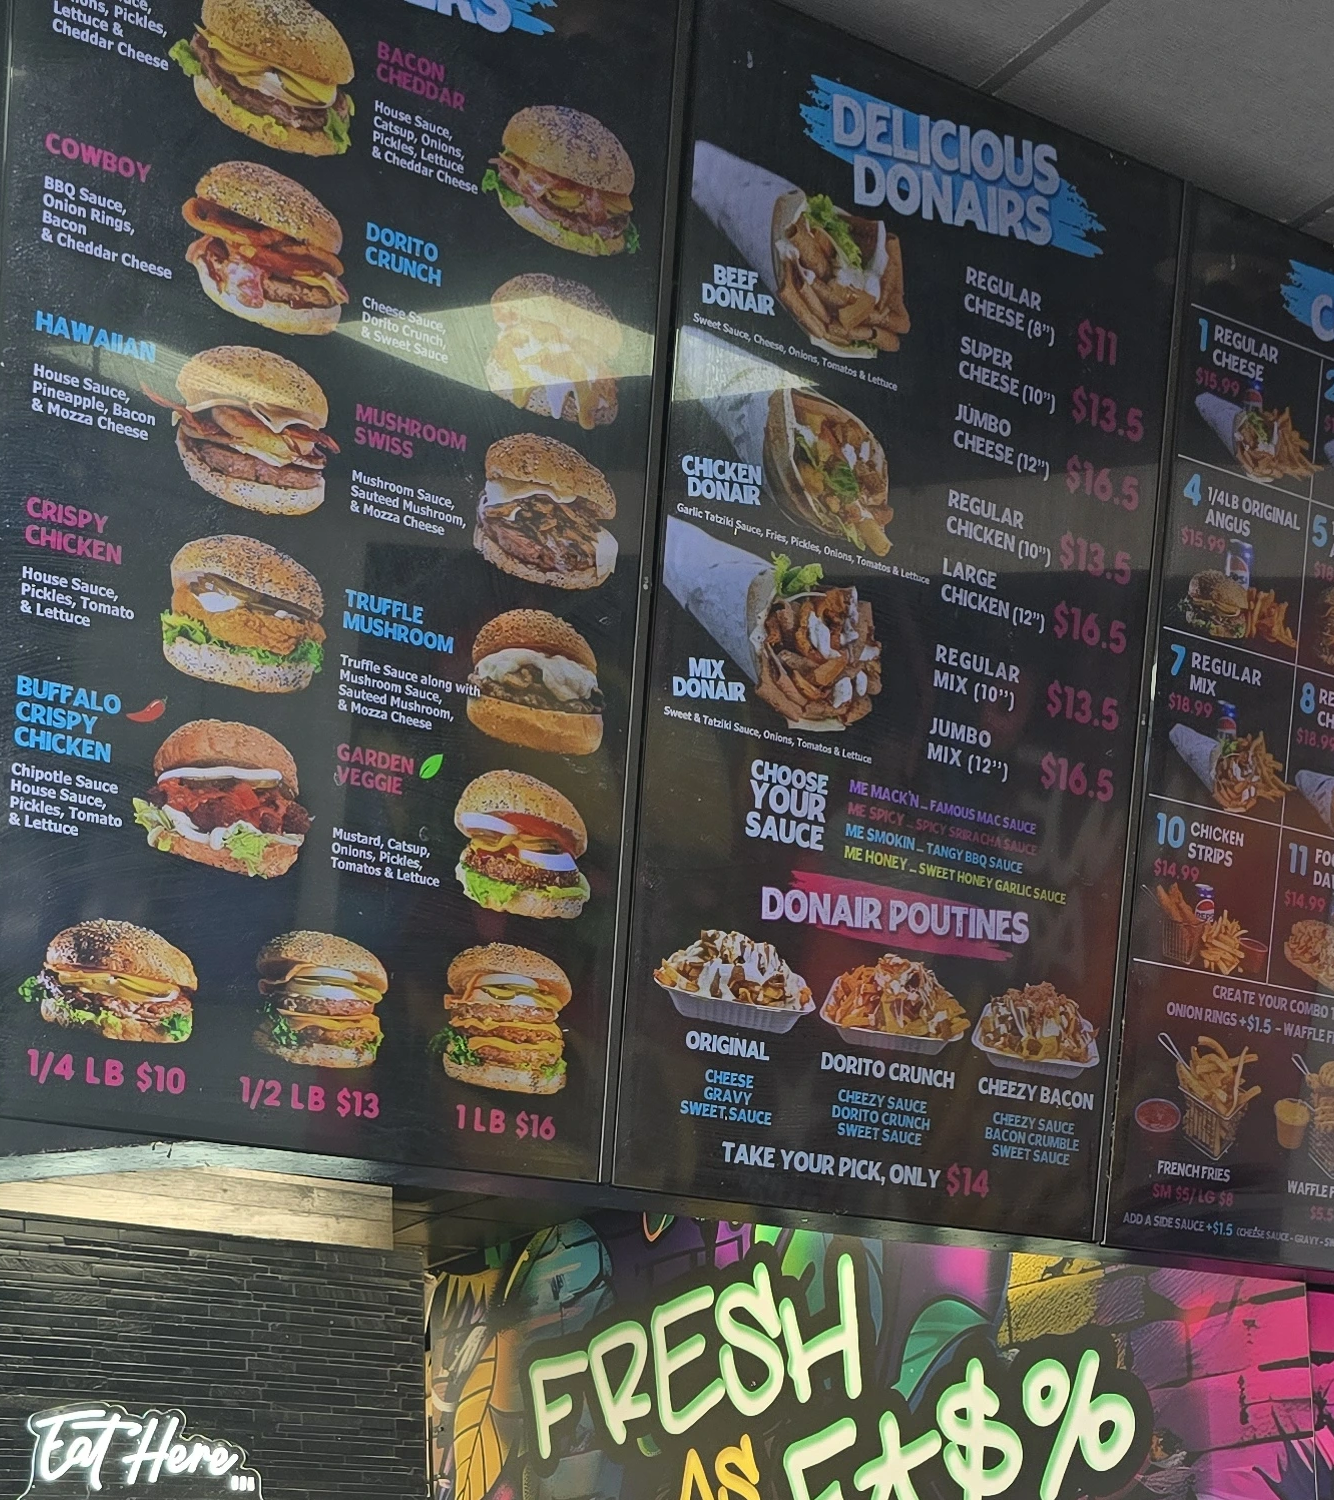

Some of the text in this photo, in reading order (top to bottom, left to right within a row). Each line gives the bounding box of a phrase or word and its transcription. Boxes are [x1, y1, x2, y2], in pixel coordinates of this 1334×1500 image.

[377, 41, 445, 82] BACON
[376, 63, 465, 111] CHEDDAR
[45, 132, 152, 183] COWBOY
[832, 93, 1061, 195] DELICIOUS
[43, 193, 135, 235] Onion Rings,
[44, 175, 127, 216] BBQ Sauce,
[853, 155, 1054, 247] DONAIRS
[42, 210, 87, 235] Bacon
[41, 227, 173, 279] & Cheddar Cheese
[366, 222, 438, 262] DORITO
[365, 247, 442, 287] CRUNCH
[713, 264, 759, 291] BEEF
[702, 283, 775, 316] DONAIR
[35, 310, 156, 363] HAWAIIAN
[693, 313, 898, 392] Sweet Sauce, Cheese, Onions, Tomatos & Lettuce
[354, 427, 413, 459] SWISS
[356, 404, 467, 451] MUSHROOM
[681, 455, 762, 485] CHICKEN
[687, 477, 761, 505] DONAIR
[26, 497, 109, 533] CRISPY
[25, 524, 122, 564] CHICKEN
[21, 583, 135, 620] Pickles, Tomato
[22, 566, 118, 602] House Sauce,
[20, 600, 91, 627] & Lettuce
[345, 589, 424, 624] TRUFFLE
[343, 611, 454, 654] MUSHROOM
[688, 657, 725, 680] MIX
[17, 675, 121, 714] BUFFALO
[672, 676, 746, 702] DONAIR
[1299, 682, 1316, 715] 8
[15, 701, 98, 734] CRISPY
[14, 726, 111, 763] CHICKEN
[337, 743, 414, 775] GARDEN
[337, 765, 402, 795] VEGGIE
[751, 759, 829, 795] CHOOSE
[750, 779, 826, 823] YOUR
[745, 811, 825, 851] SAUCE
[1156, 812, 1245, 849] 10 CHICKEN
[1188, 843, 1234, 868] STRIPS
[844, 845, 862, 861] ME
[865, 850, 908, 873] HONEY
[919, 862, 955, 881] SWEET
[957, 872, 994, 889] HONEY
[995, 879, 1032, 898] GARLIC
[1033, 889, 1067, 905] SAUCE
[761, 886, 1030, 945] DONAIR POUTINES
[685, 1030, 770, 1061] ORIGINAL
[27, 1048, 186, 1095] 1/4 LB $10
[820, 1051, 955, 1090] DORITO CRUNCH
[239, 1075, 380, 1119] 1/2 LB $13
[977, 1076, 1094, 1111] CHEEZY BACON
[456, 1104, 556, 1142] 1 LB $16
[722, 1141, 990, 1199] TAKE YOUR PICK, ONLY $14
[1157, 1160, 1231, 1183] FRENCH FRIES
[1287, 1180, 1329, 1198] WAFFLE
[527, 1252, 863, 1459] FRESH
[35, 1409, 256, 1492] Eat Here...
